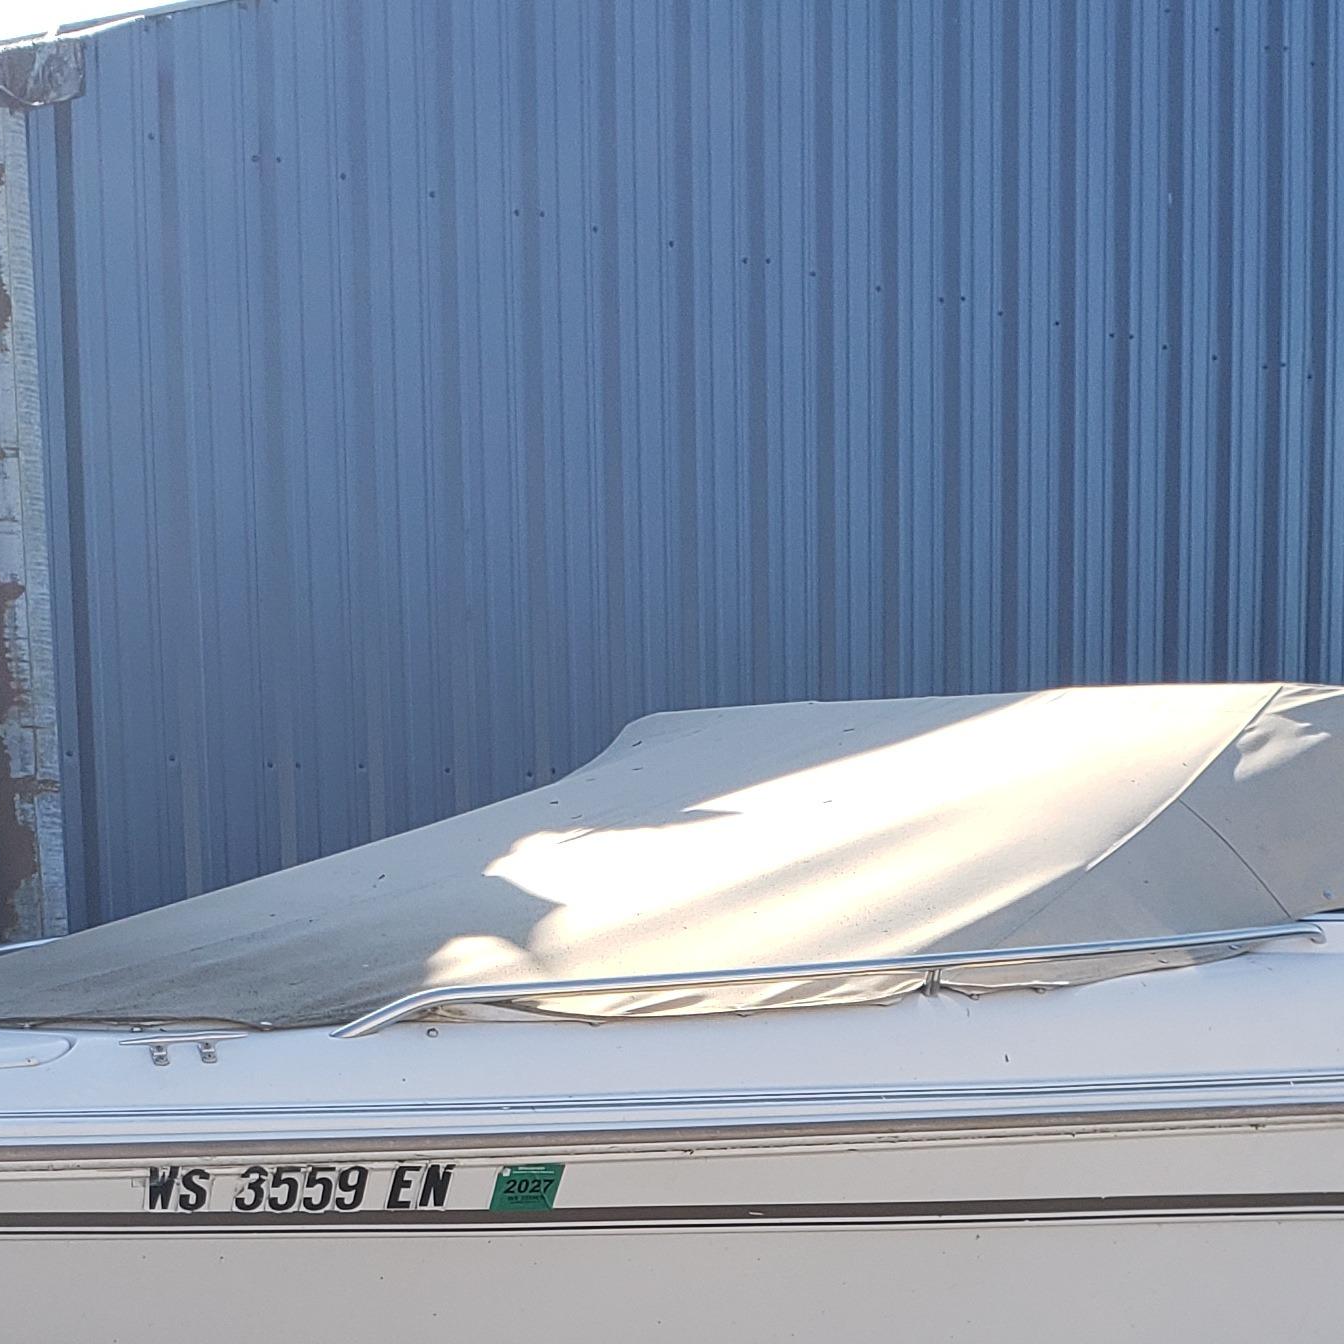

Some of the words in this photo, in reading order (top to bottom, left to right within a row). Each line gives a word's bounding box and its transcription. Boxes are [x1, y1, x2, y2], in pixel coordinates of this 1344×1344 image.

[148, 1165, 210, 1211] WS
[234, 1165, 368, 1211] 3559
[386, 1163, 454, 1210] EN
[504, 1179, 555, 1194] 2027
